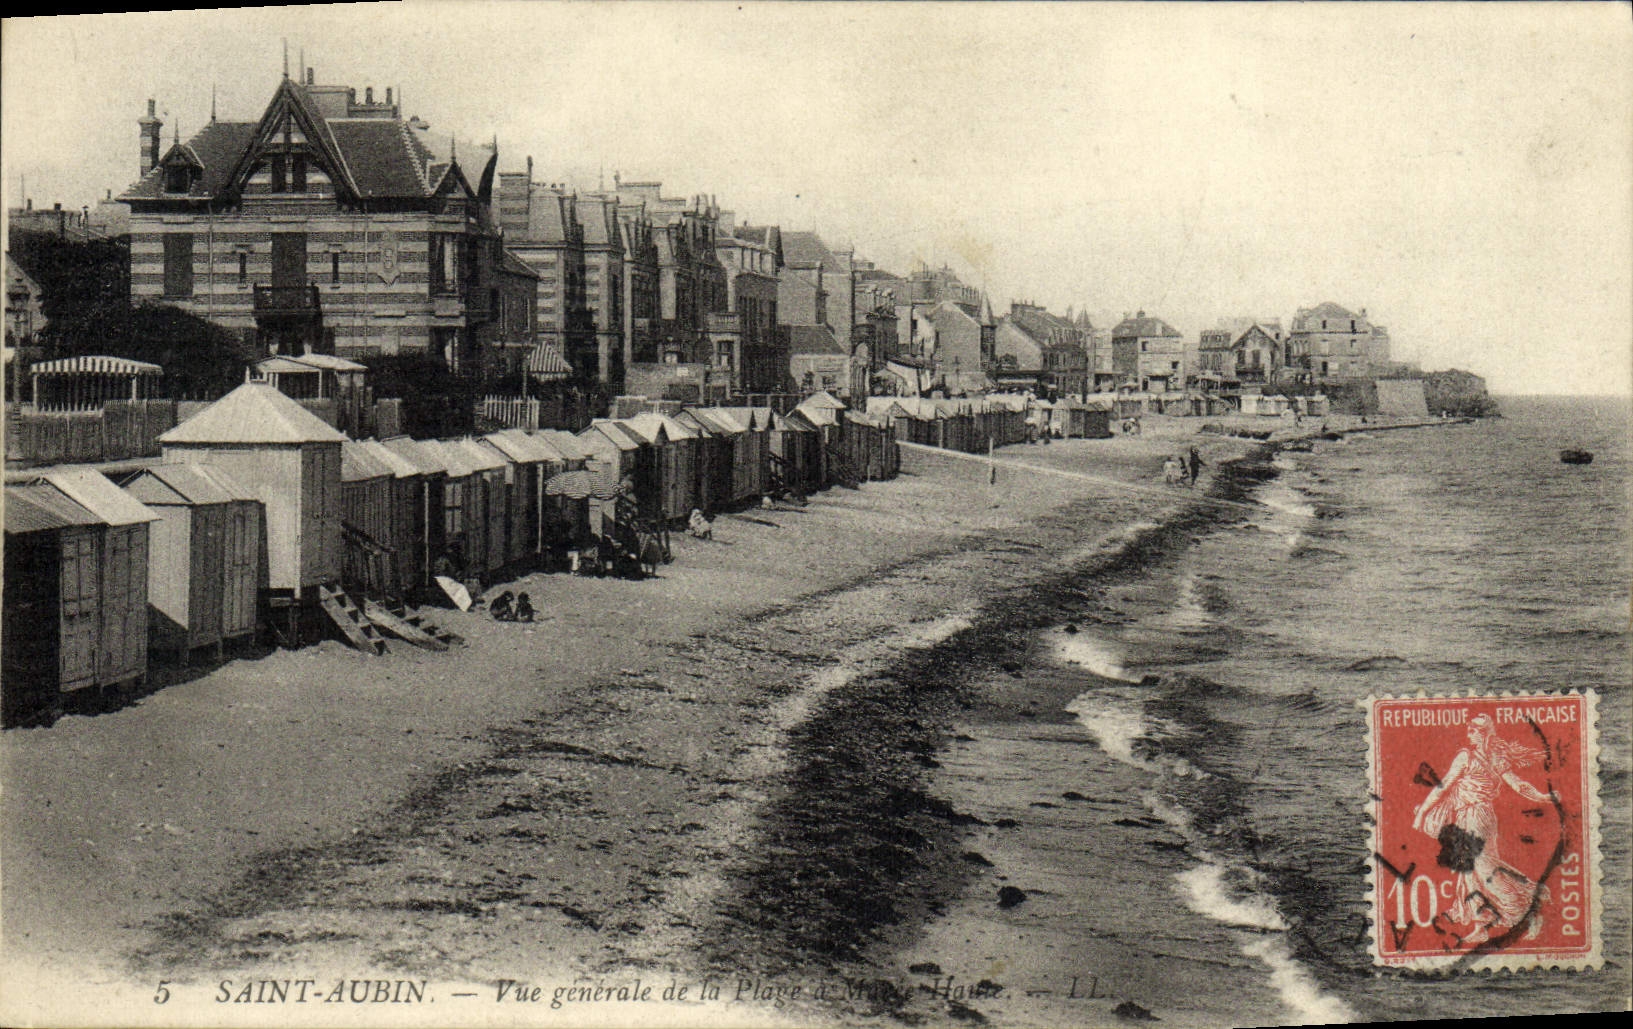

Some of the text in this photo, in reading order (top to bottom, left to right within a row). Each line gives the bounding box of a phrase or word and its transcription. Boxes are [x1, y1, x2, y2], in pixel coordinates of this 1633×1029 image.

[1382, 704, 1577, 728] REPUBLIQUE FRANÇAISE
[1561, 851, 1581, 937] POSTES
